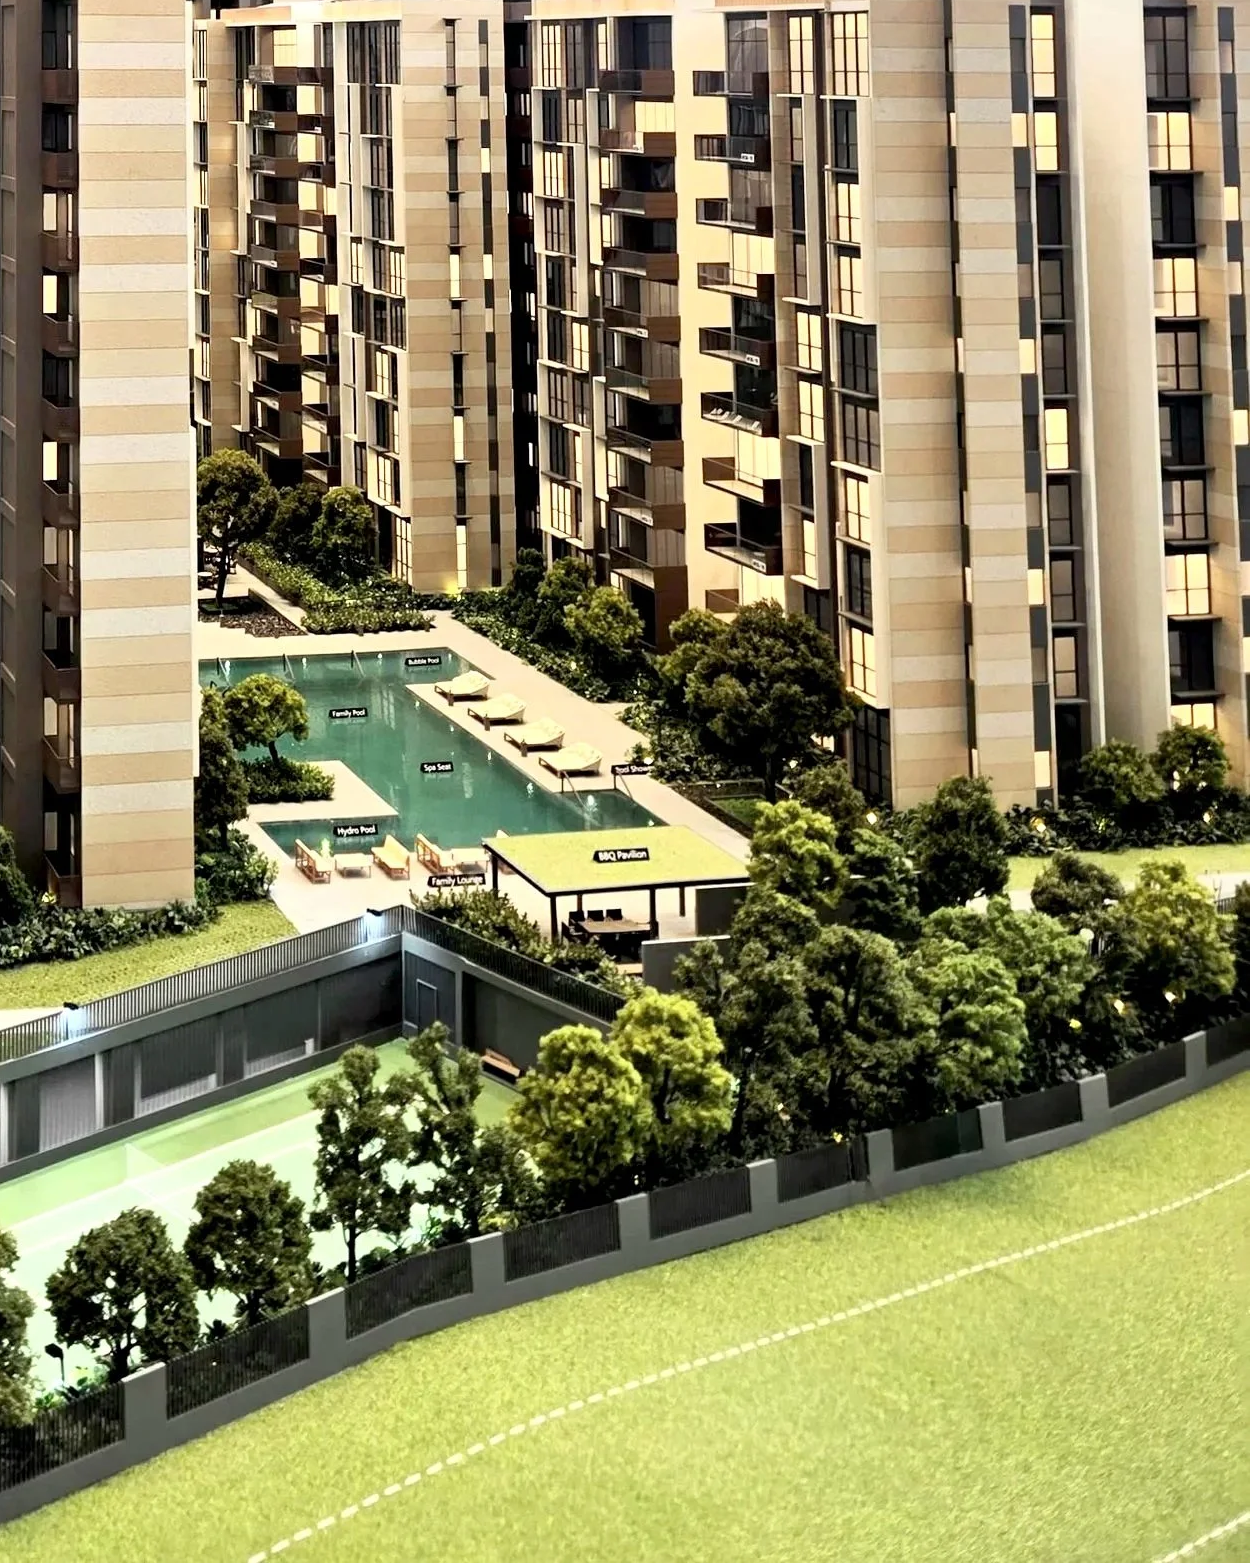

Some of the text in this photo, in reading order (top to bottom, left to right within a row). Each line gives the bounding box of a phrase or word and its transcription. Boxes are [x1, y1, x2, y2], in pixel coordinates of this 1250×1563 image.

[332, 710, 352, 719] Family
[424, 764, 436, 773] Spa
[337, 825, 376, 837] Hydro Pool
[598, 848, 648, 862] BBQ Pavilion
[431, 875, 484, 888] Family Lounge
